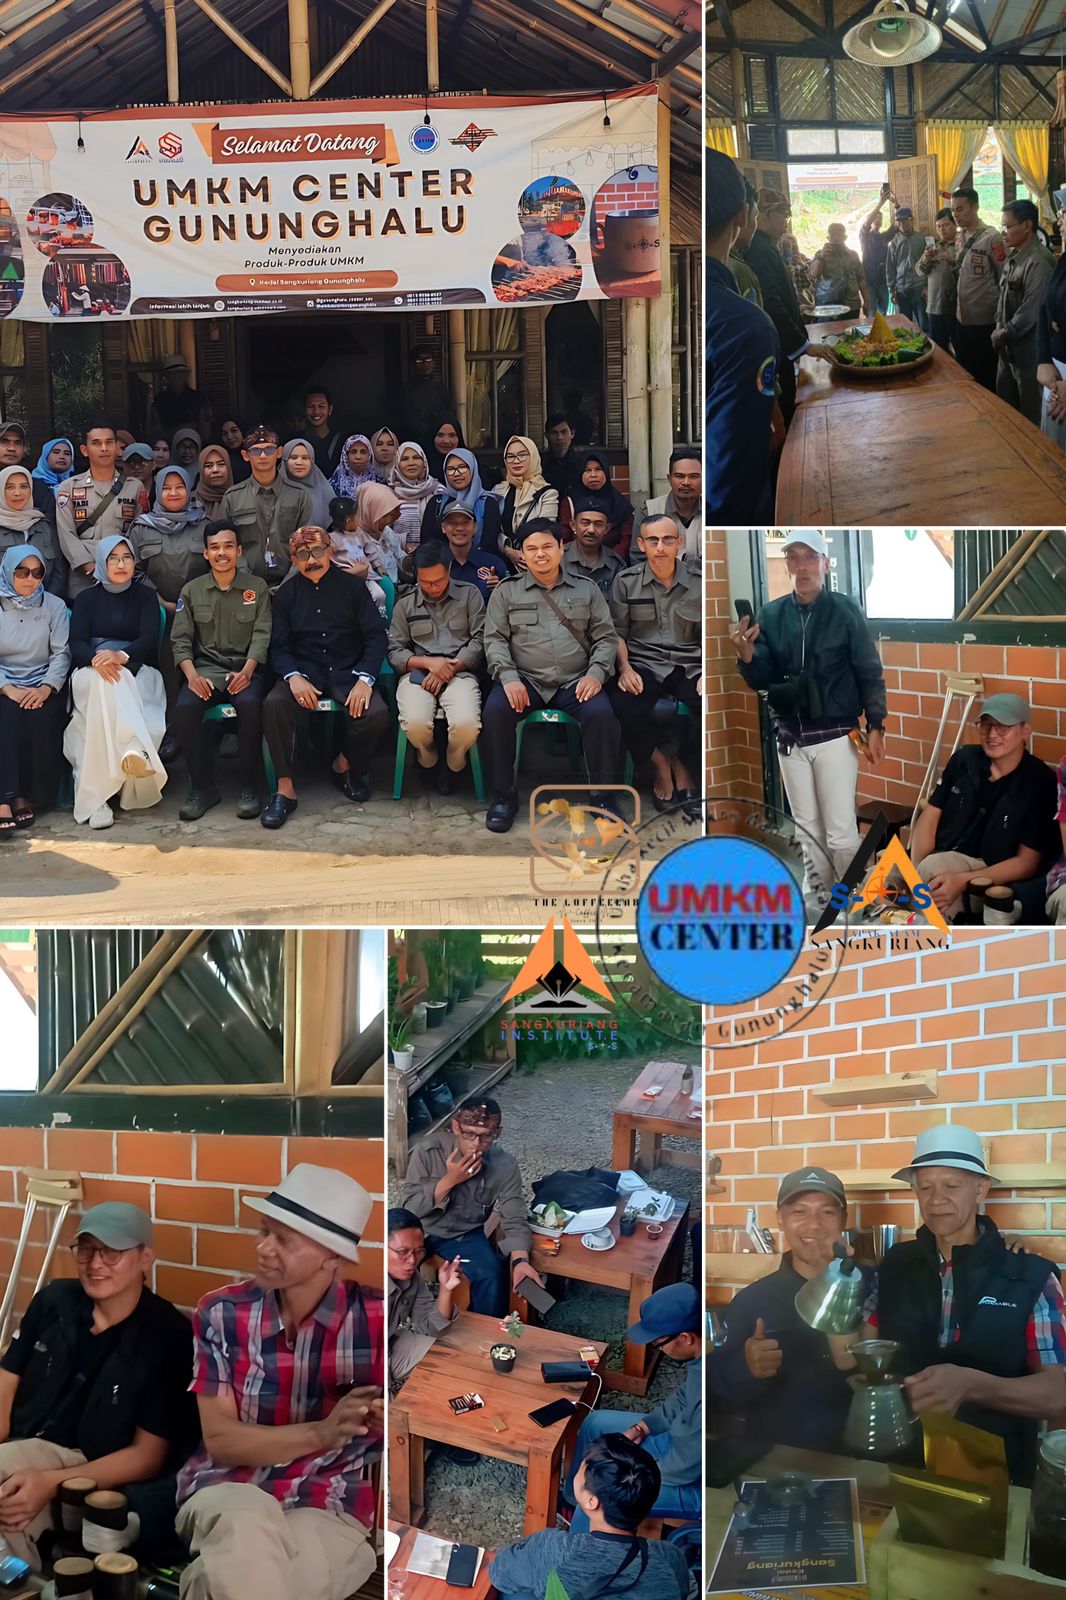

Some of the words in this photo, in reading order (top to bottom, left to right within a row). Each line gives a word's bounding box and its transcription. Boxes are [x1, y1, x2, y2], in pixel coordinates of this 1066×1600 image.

[221, 135, 302, 156] Selamat
[304, 133, 381, 156] Datang
[133, 176, 271, 208] UMKM
[292, 168, 474, 202] CENTER
[143, 205, 466, 243] GUNUNGHALU
[268, 245, 342, 257] Menyediakan
[244, 258, 327, 268] Produk-Produk
[329, 256, 365, 266] UMKM
[280, 278, 323, 287] Sangkuriang
[323, 277, 366, 286] Gununghalu
[746, 1558, 837, 1570] Sangkuriang
